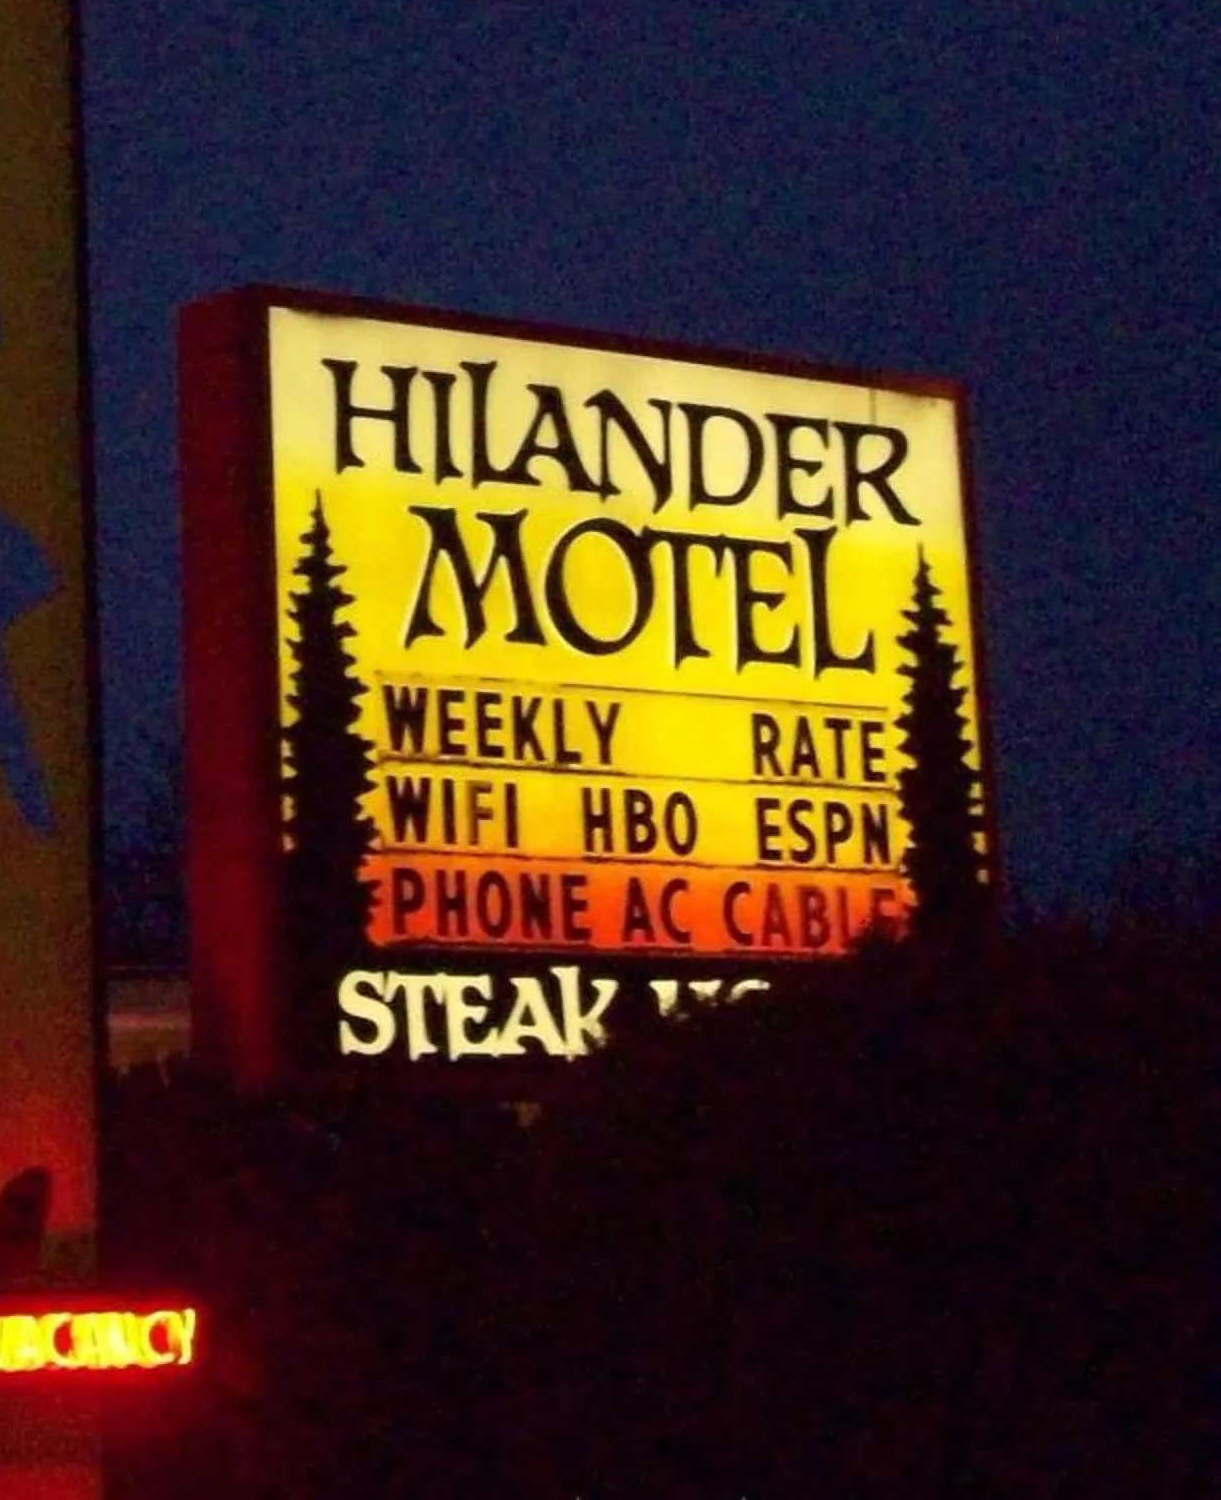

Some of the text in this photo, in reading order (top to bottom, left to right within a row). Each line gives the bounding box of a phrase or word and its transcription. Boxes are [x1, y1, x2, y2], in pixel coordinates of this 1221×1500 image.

[322, 357, 921, 526] HILANDER
[403, 505, 875, 680] MOTEL
[382, 683, 887, 784] WEEKLY RATE
[386, 776, 891, 865] WIFI HBO ESPN
[391, 867, 593, 942] PHONE
[621, 877, 692, 943] AC
[338, 966, 618, 1062] STEAK
